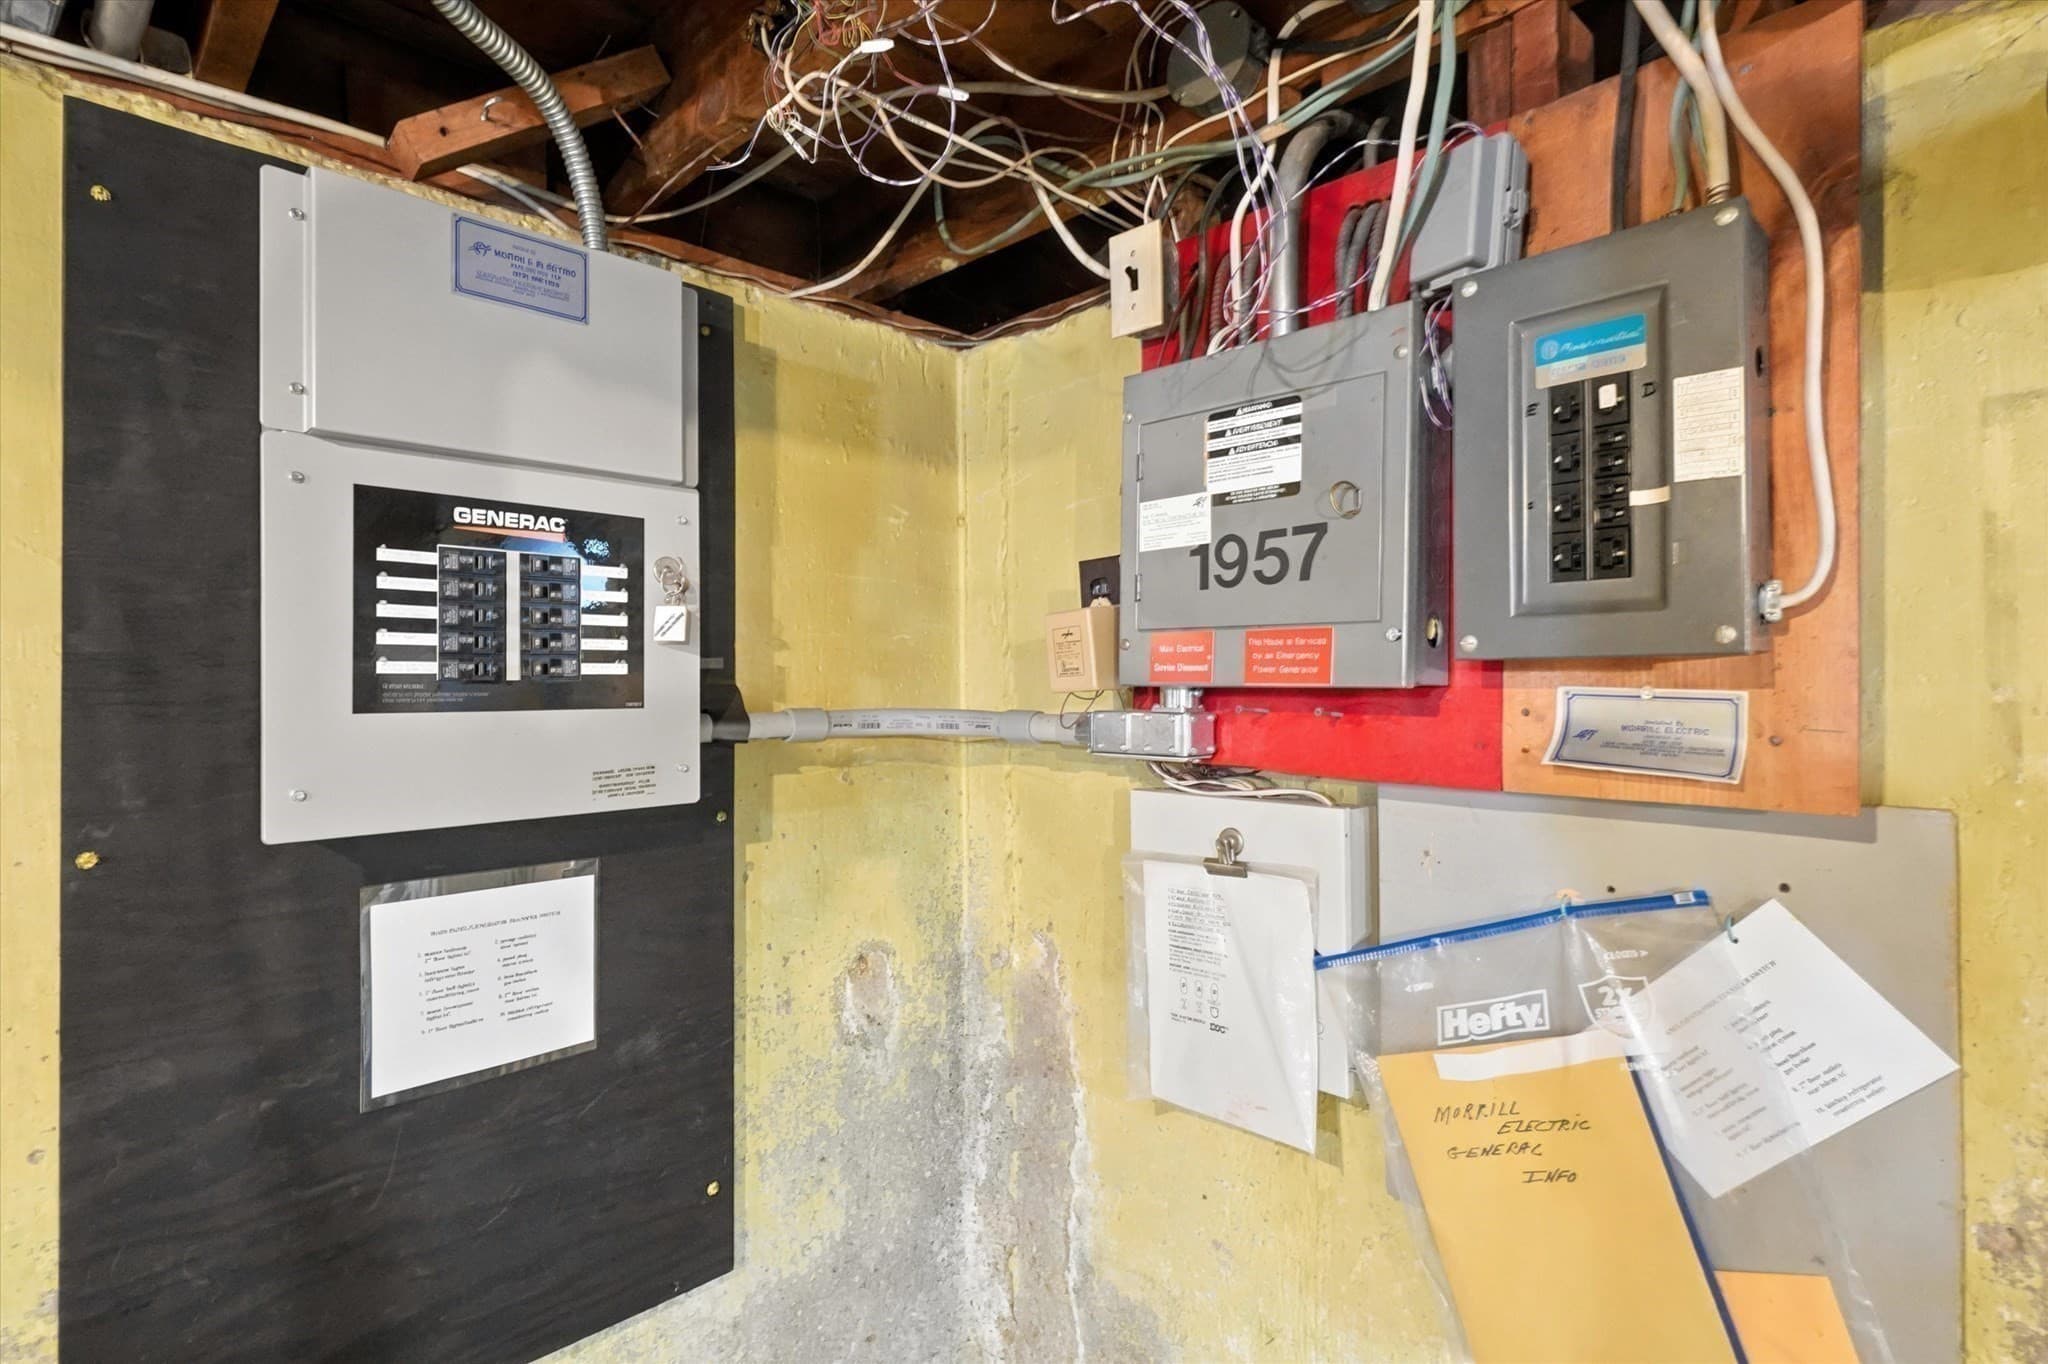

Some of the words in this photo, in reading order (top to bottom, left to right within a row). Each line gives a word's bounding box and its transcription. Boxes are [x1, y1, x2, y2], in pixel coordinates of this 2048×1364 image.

[453, 506, 566, 533] GENERAC
[1189, 521, 1328, 591] 1957
[1275, 651, 1321, 661] Emergency
[1252, 665, 1276, 674] Power
[1278, 664, 1319, 674] Generator
[1443, 1001, 1540, 1039] Hefty
[1433, 1100, 1521, 1125] MORRILL
[1447, 1140, 1544, 1160] GENERAC
[1521, 1167, 1578, 1184] INFO
